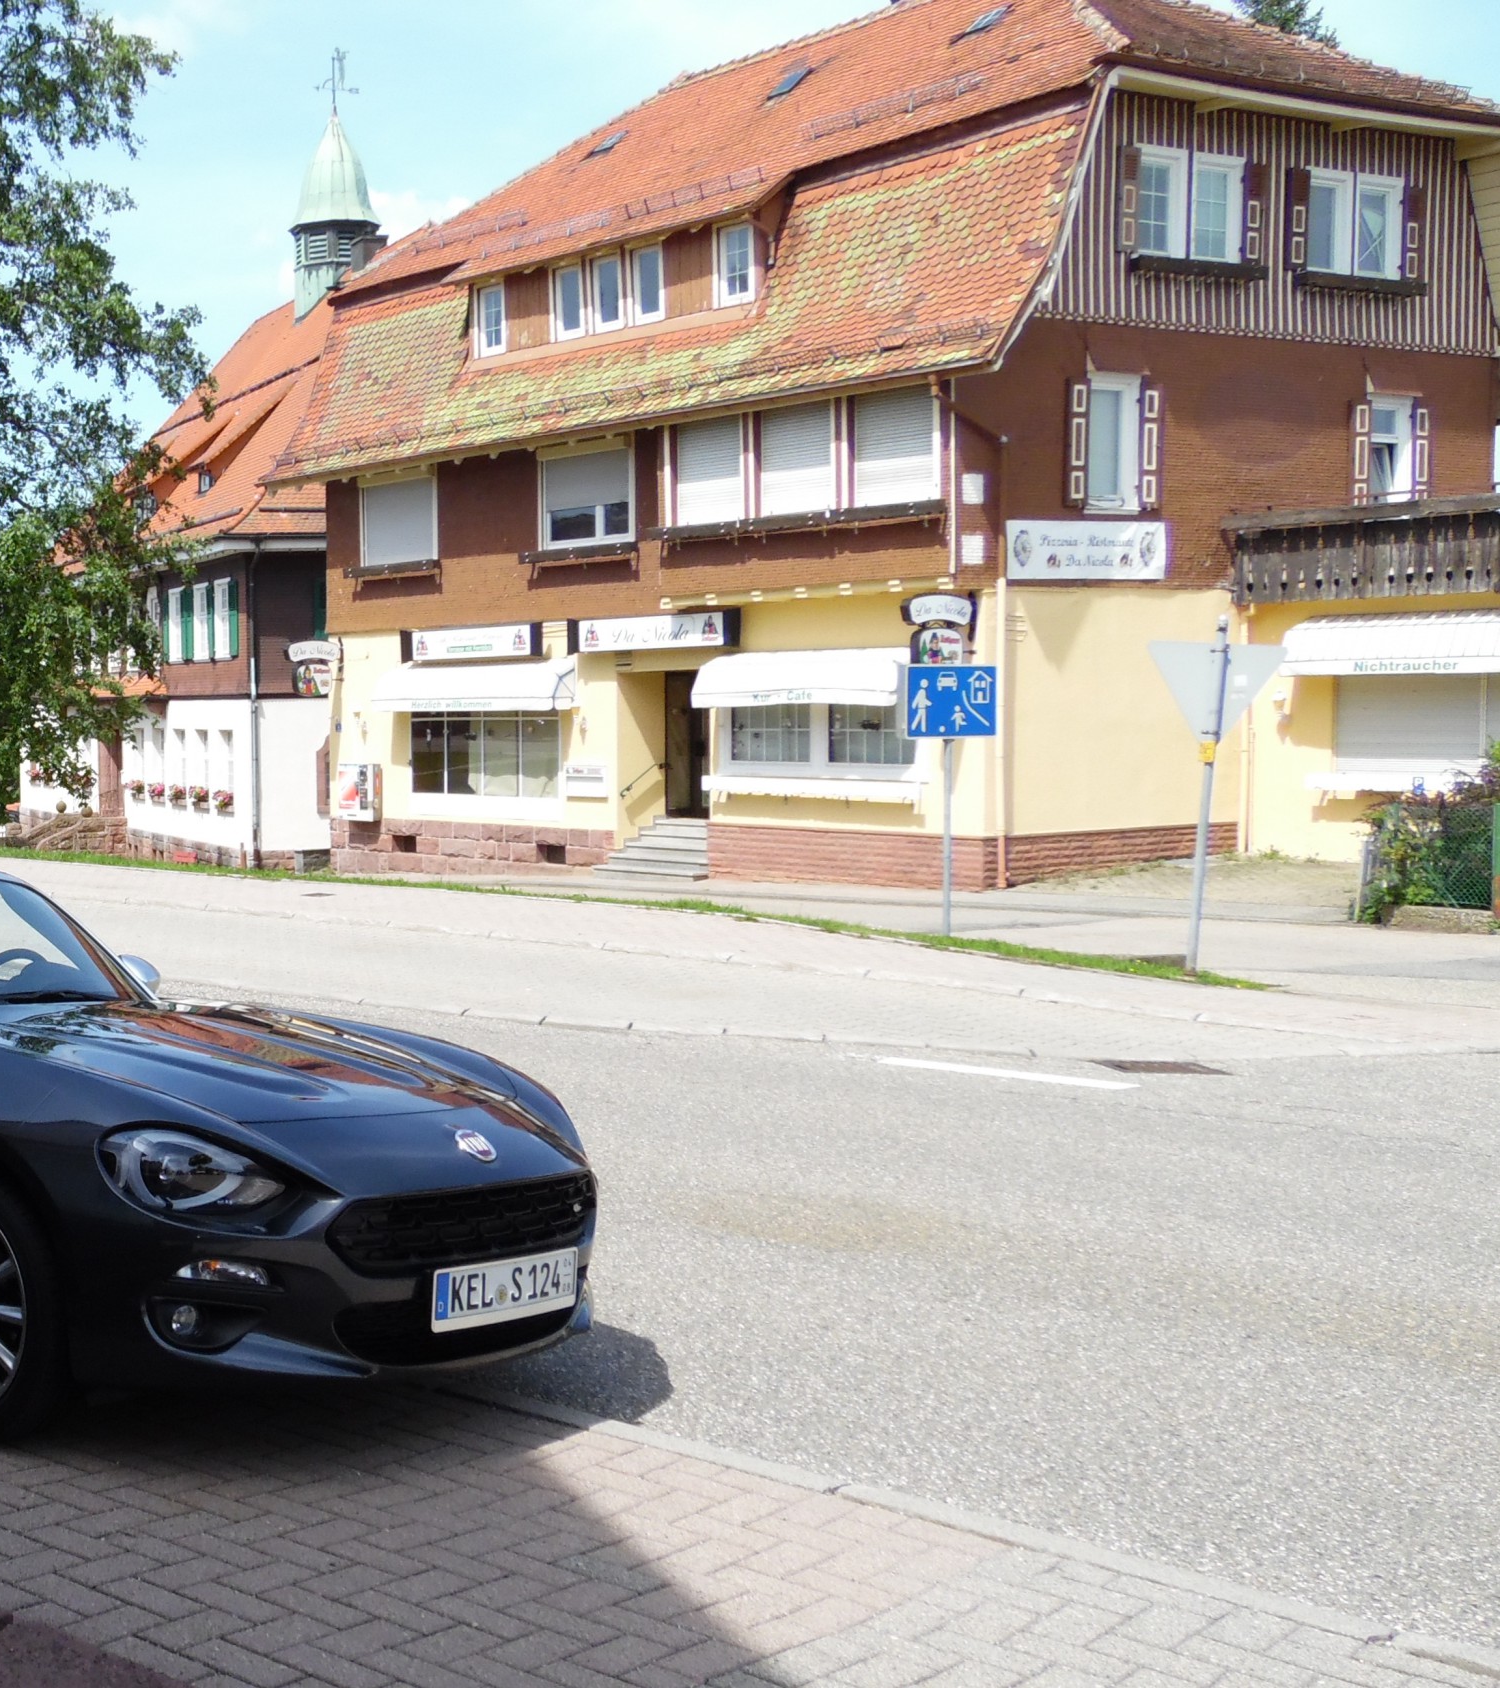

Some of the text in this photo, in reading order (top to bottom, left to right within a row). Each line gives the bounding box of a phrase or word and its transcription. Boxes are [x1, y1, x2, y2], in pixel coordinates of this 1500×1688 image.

[1039, 534, 1078, 547] Pizzeria
[1065, 554, 1114, 567] Da Nicola
[915, 601, 968, 618] Da Nicola
[612, 622, 689, 644] Da Nicola
[292, 643, 336, 658] Da Nicola
[1353, 659, 1459, 672] Nichtraucher
[411, 700, 493, 710] Herzlich willkommen
[451, 1272, 494, 1313] KEL
